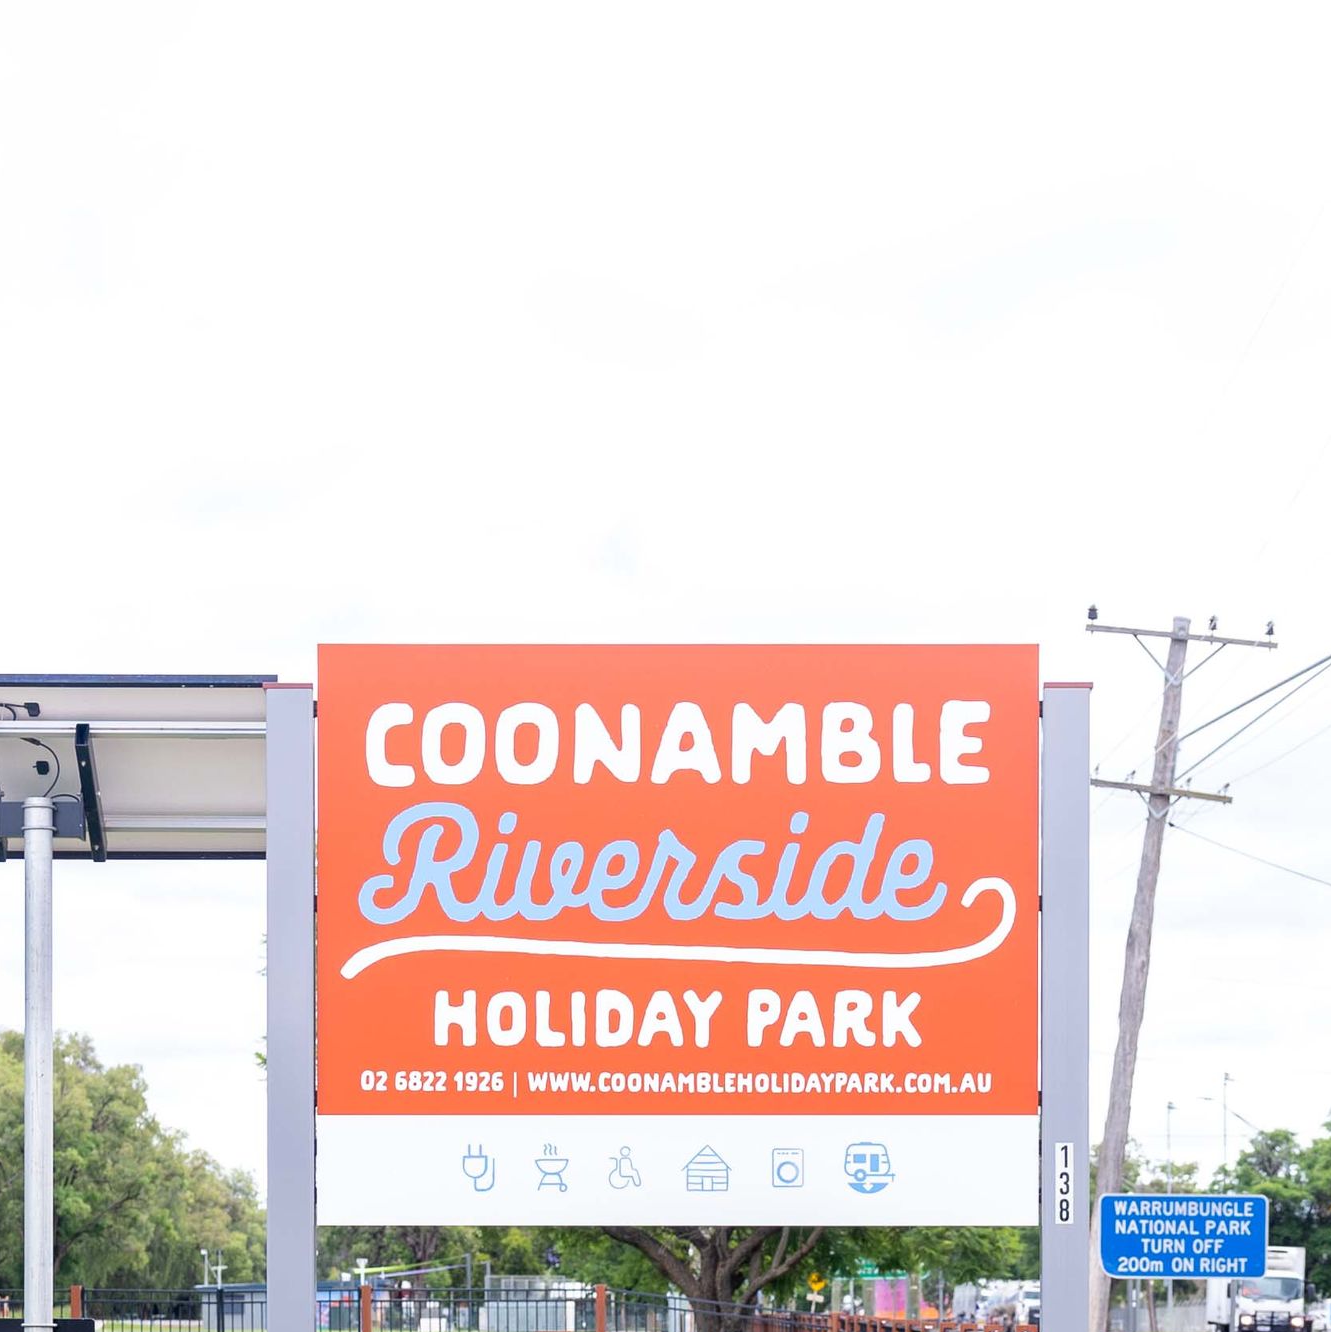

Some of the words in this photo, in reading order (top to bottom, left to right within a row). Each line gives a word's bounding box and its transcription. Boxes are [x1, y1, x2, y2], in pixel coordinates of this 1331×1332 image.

[365, 699, 991, 788] COONAMBLE
[357, 801, 948, 926] Riverside
[434, 988, 723, 1049] HOLIDAY
[746, 988, 923, 1049] PARK
[360, 1069, 388, 1093] 02
[394, 1069, 447, 1093] 6822
[453, 1069, 505, 1093] 1926
[527, 1071, 993, 1096] WWW.COONAMBLEHOLIDAYPARK.COM.AU
[1114, 1200, 1254, 1217] WARRUMBUNGLE
[1115, 1219, 1199, 1235] NATIONAL
[1205, 1220, 1251, 1236] PARK
[1141, 1238, 1185, 1254] TURN
[1192, 1238, 1225, 1254] OFF
[1117, 1257, 1164, 1273] 200m
[1171, 1257, 1195, 1273] ON
[1199, 1257, 1248, 1273] RIGHT
